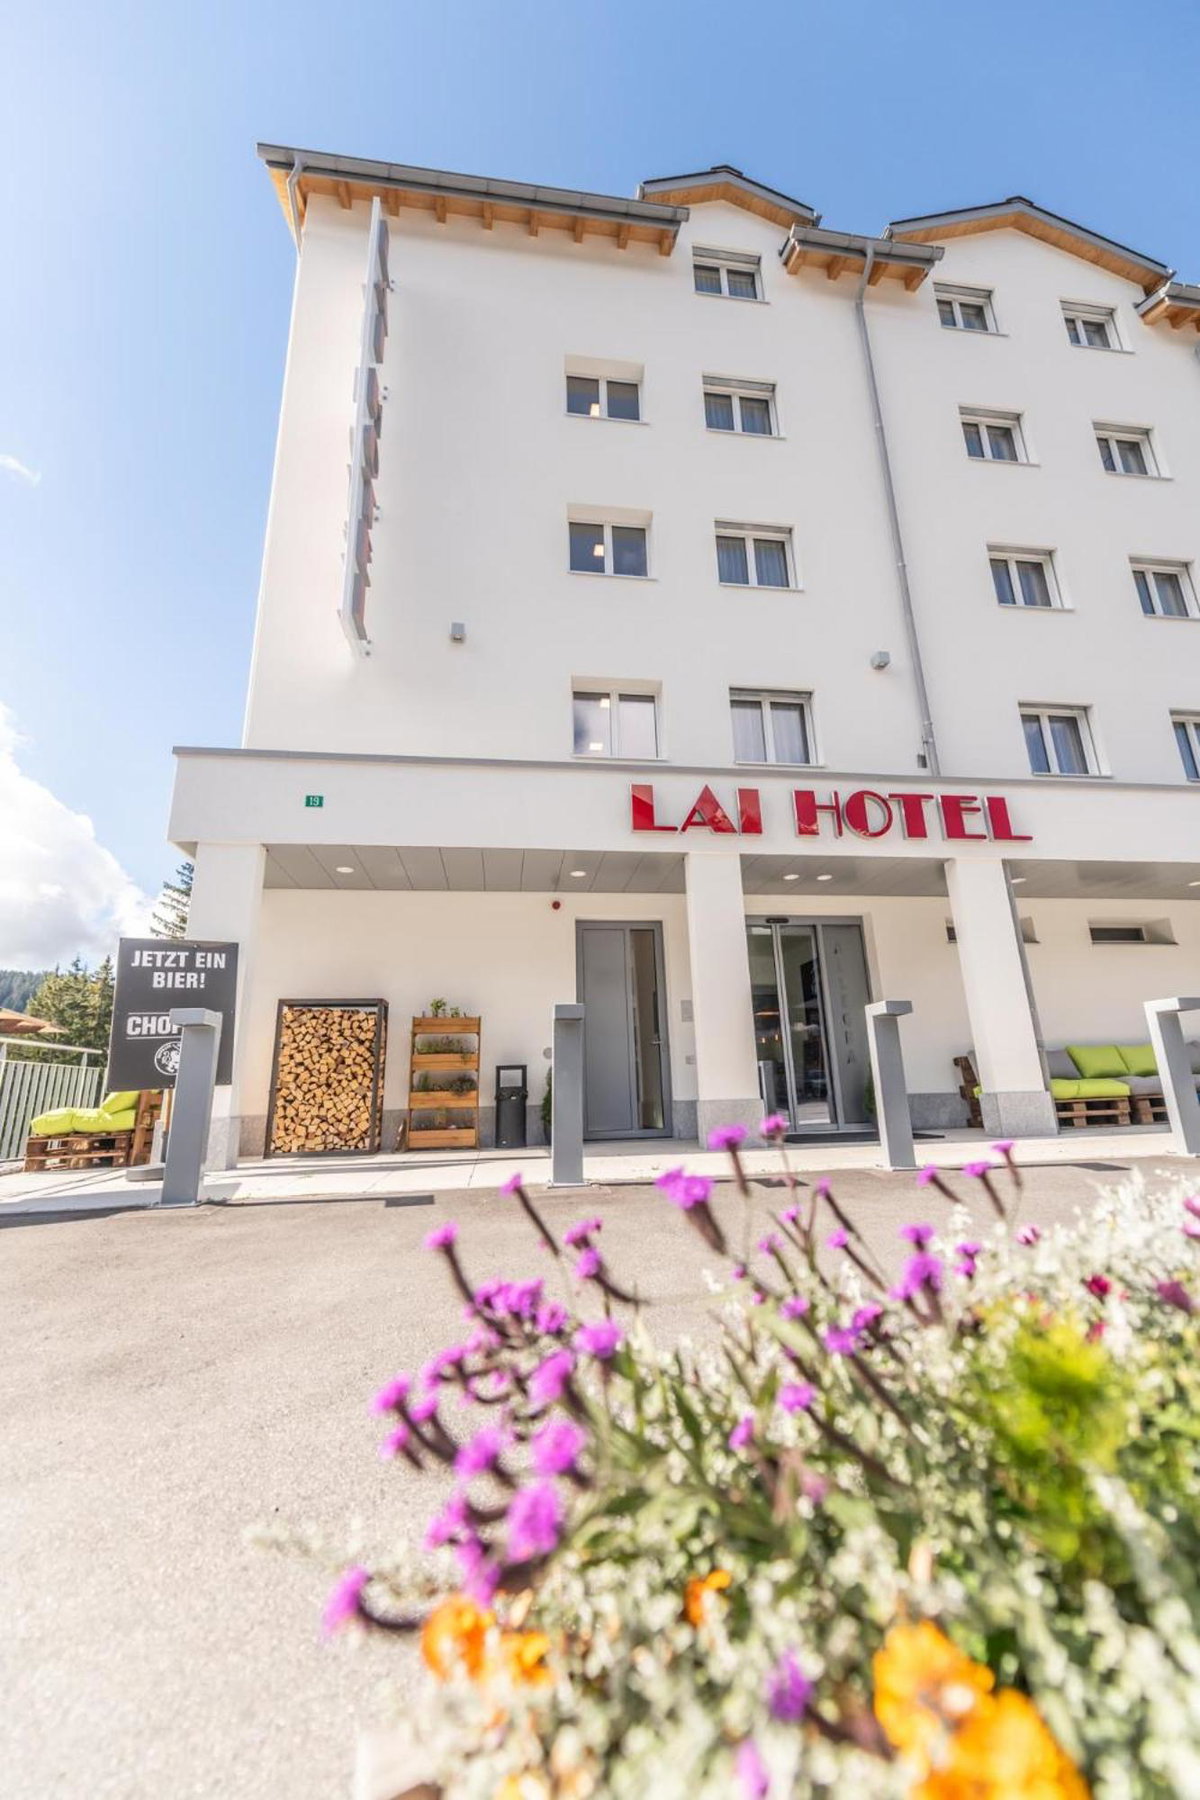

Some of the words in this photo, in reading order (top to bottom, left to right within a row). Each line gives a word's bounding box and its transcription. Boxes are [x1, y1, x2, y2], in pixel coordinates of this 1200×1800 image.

[309, 796, 320, 806] 19
[629, 783, 763, 835] LAI
[791, 788, 1034, 842] HOTEL
[131, 950, 189, 968] JETZT
[195, 953, 227, 969] EIN
[152, 971, 206, 989] BIER!
